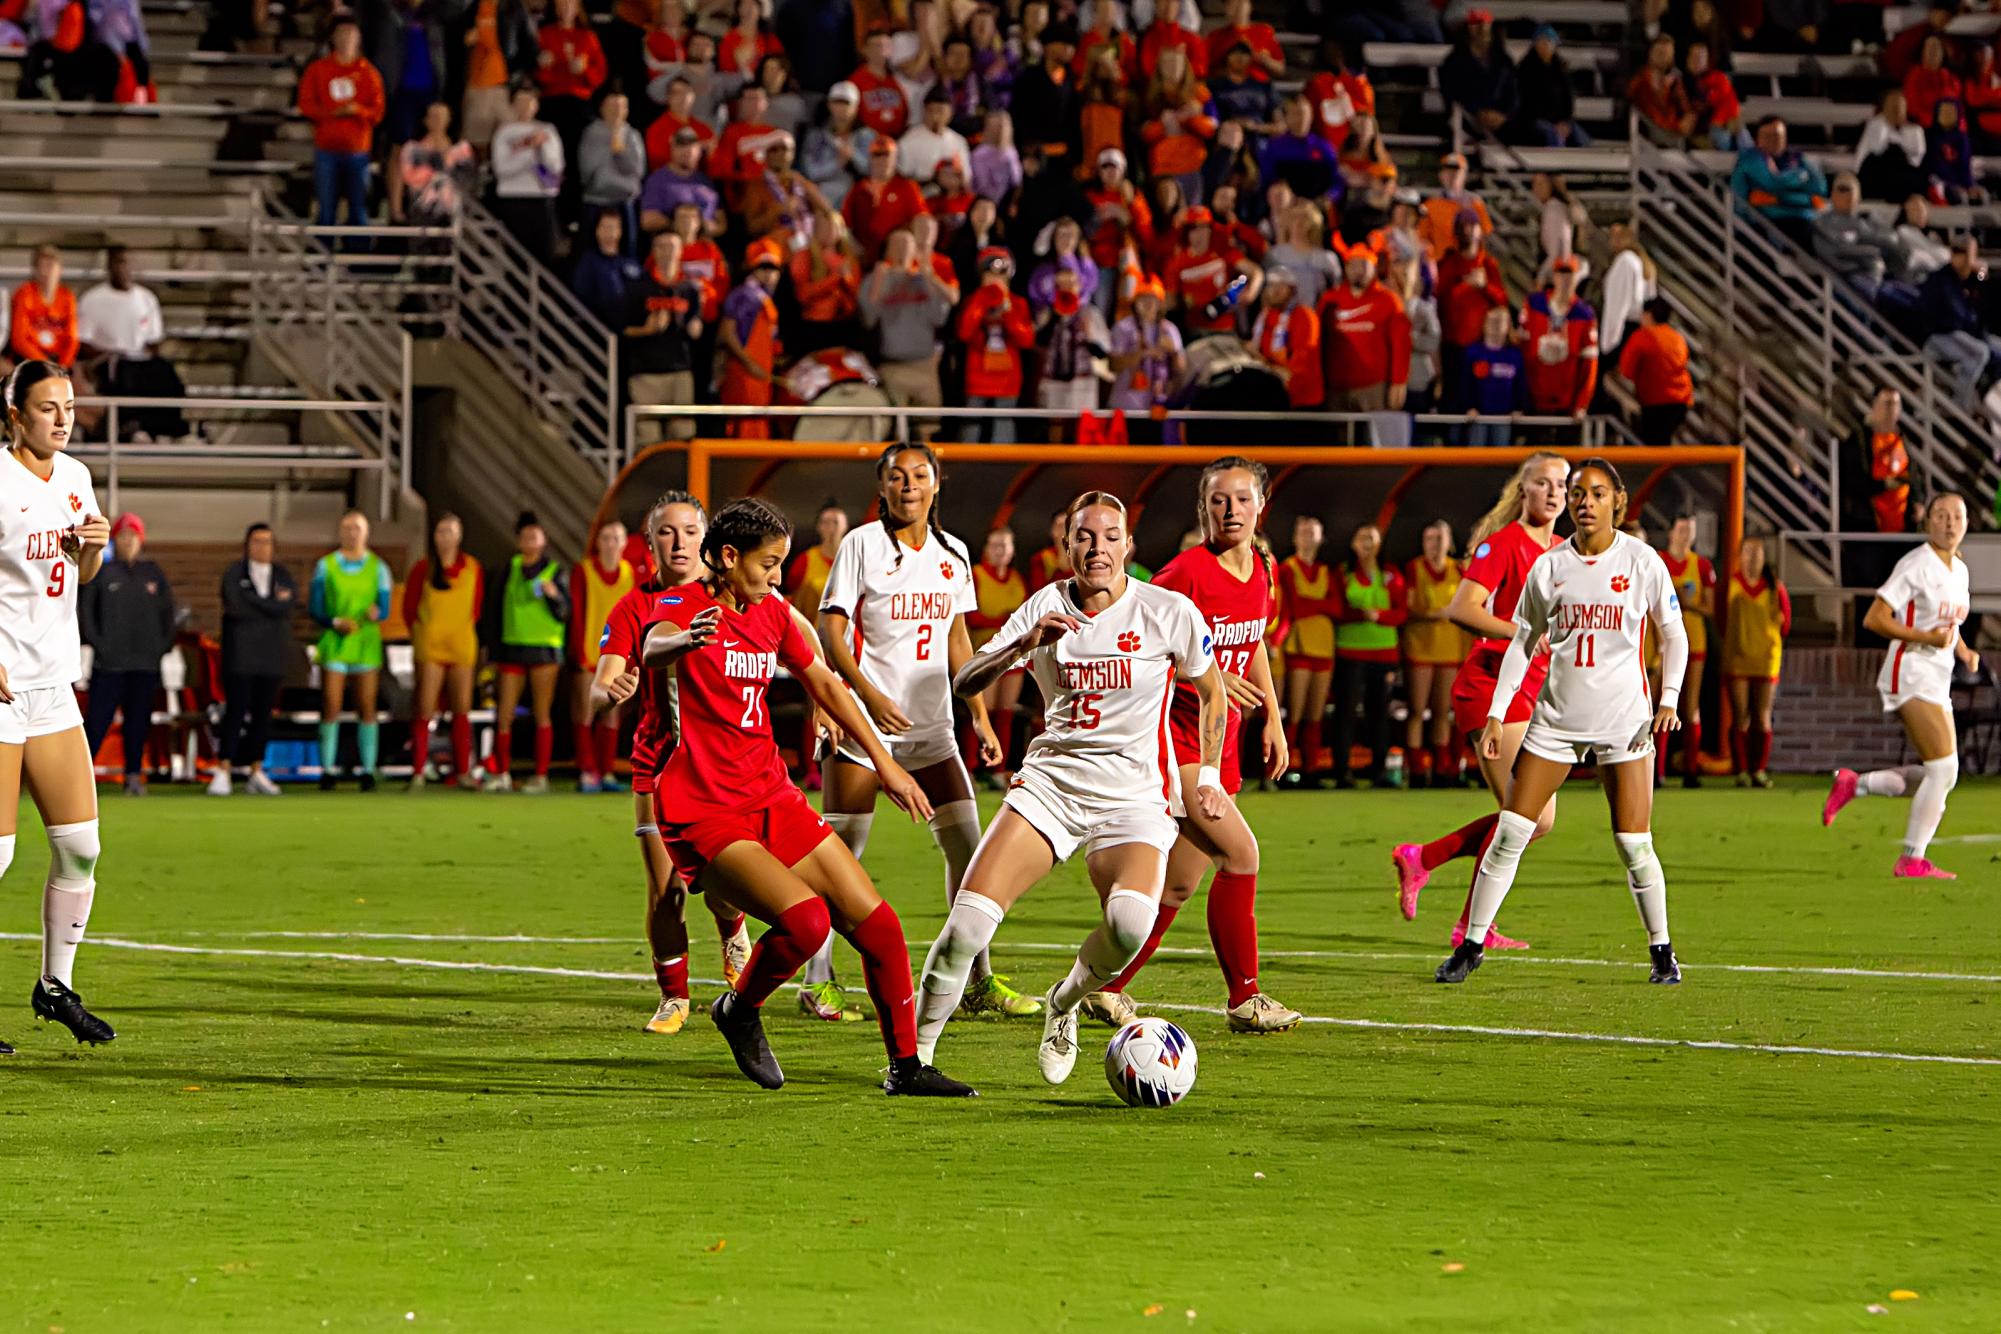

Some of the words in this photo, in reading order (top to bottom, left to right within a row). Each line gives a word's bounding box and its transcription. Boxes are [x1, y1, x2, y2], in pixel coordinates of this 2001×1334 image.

[46, 561, 65, 597] 9
[1557, 603, 1624, 631] CLEMSON
[916, 624, 932, 660] 2
[1574, 633, 1595, 667] 11
[741, 686, 765, 728] 21
[1067, 693, 1104, 730] 15
